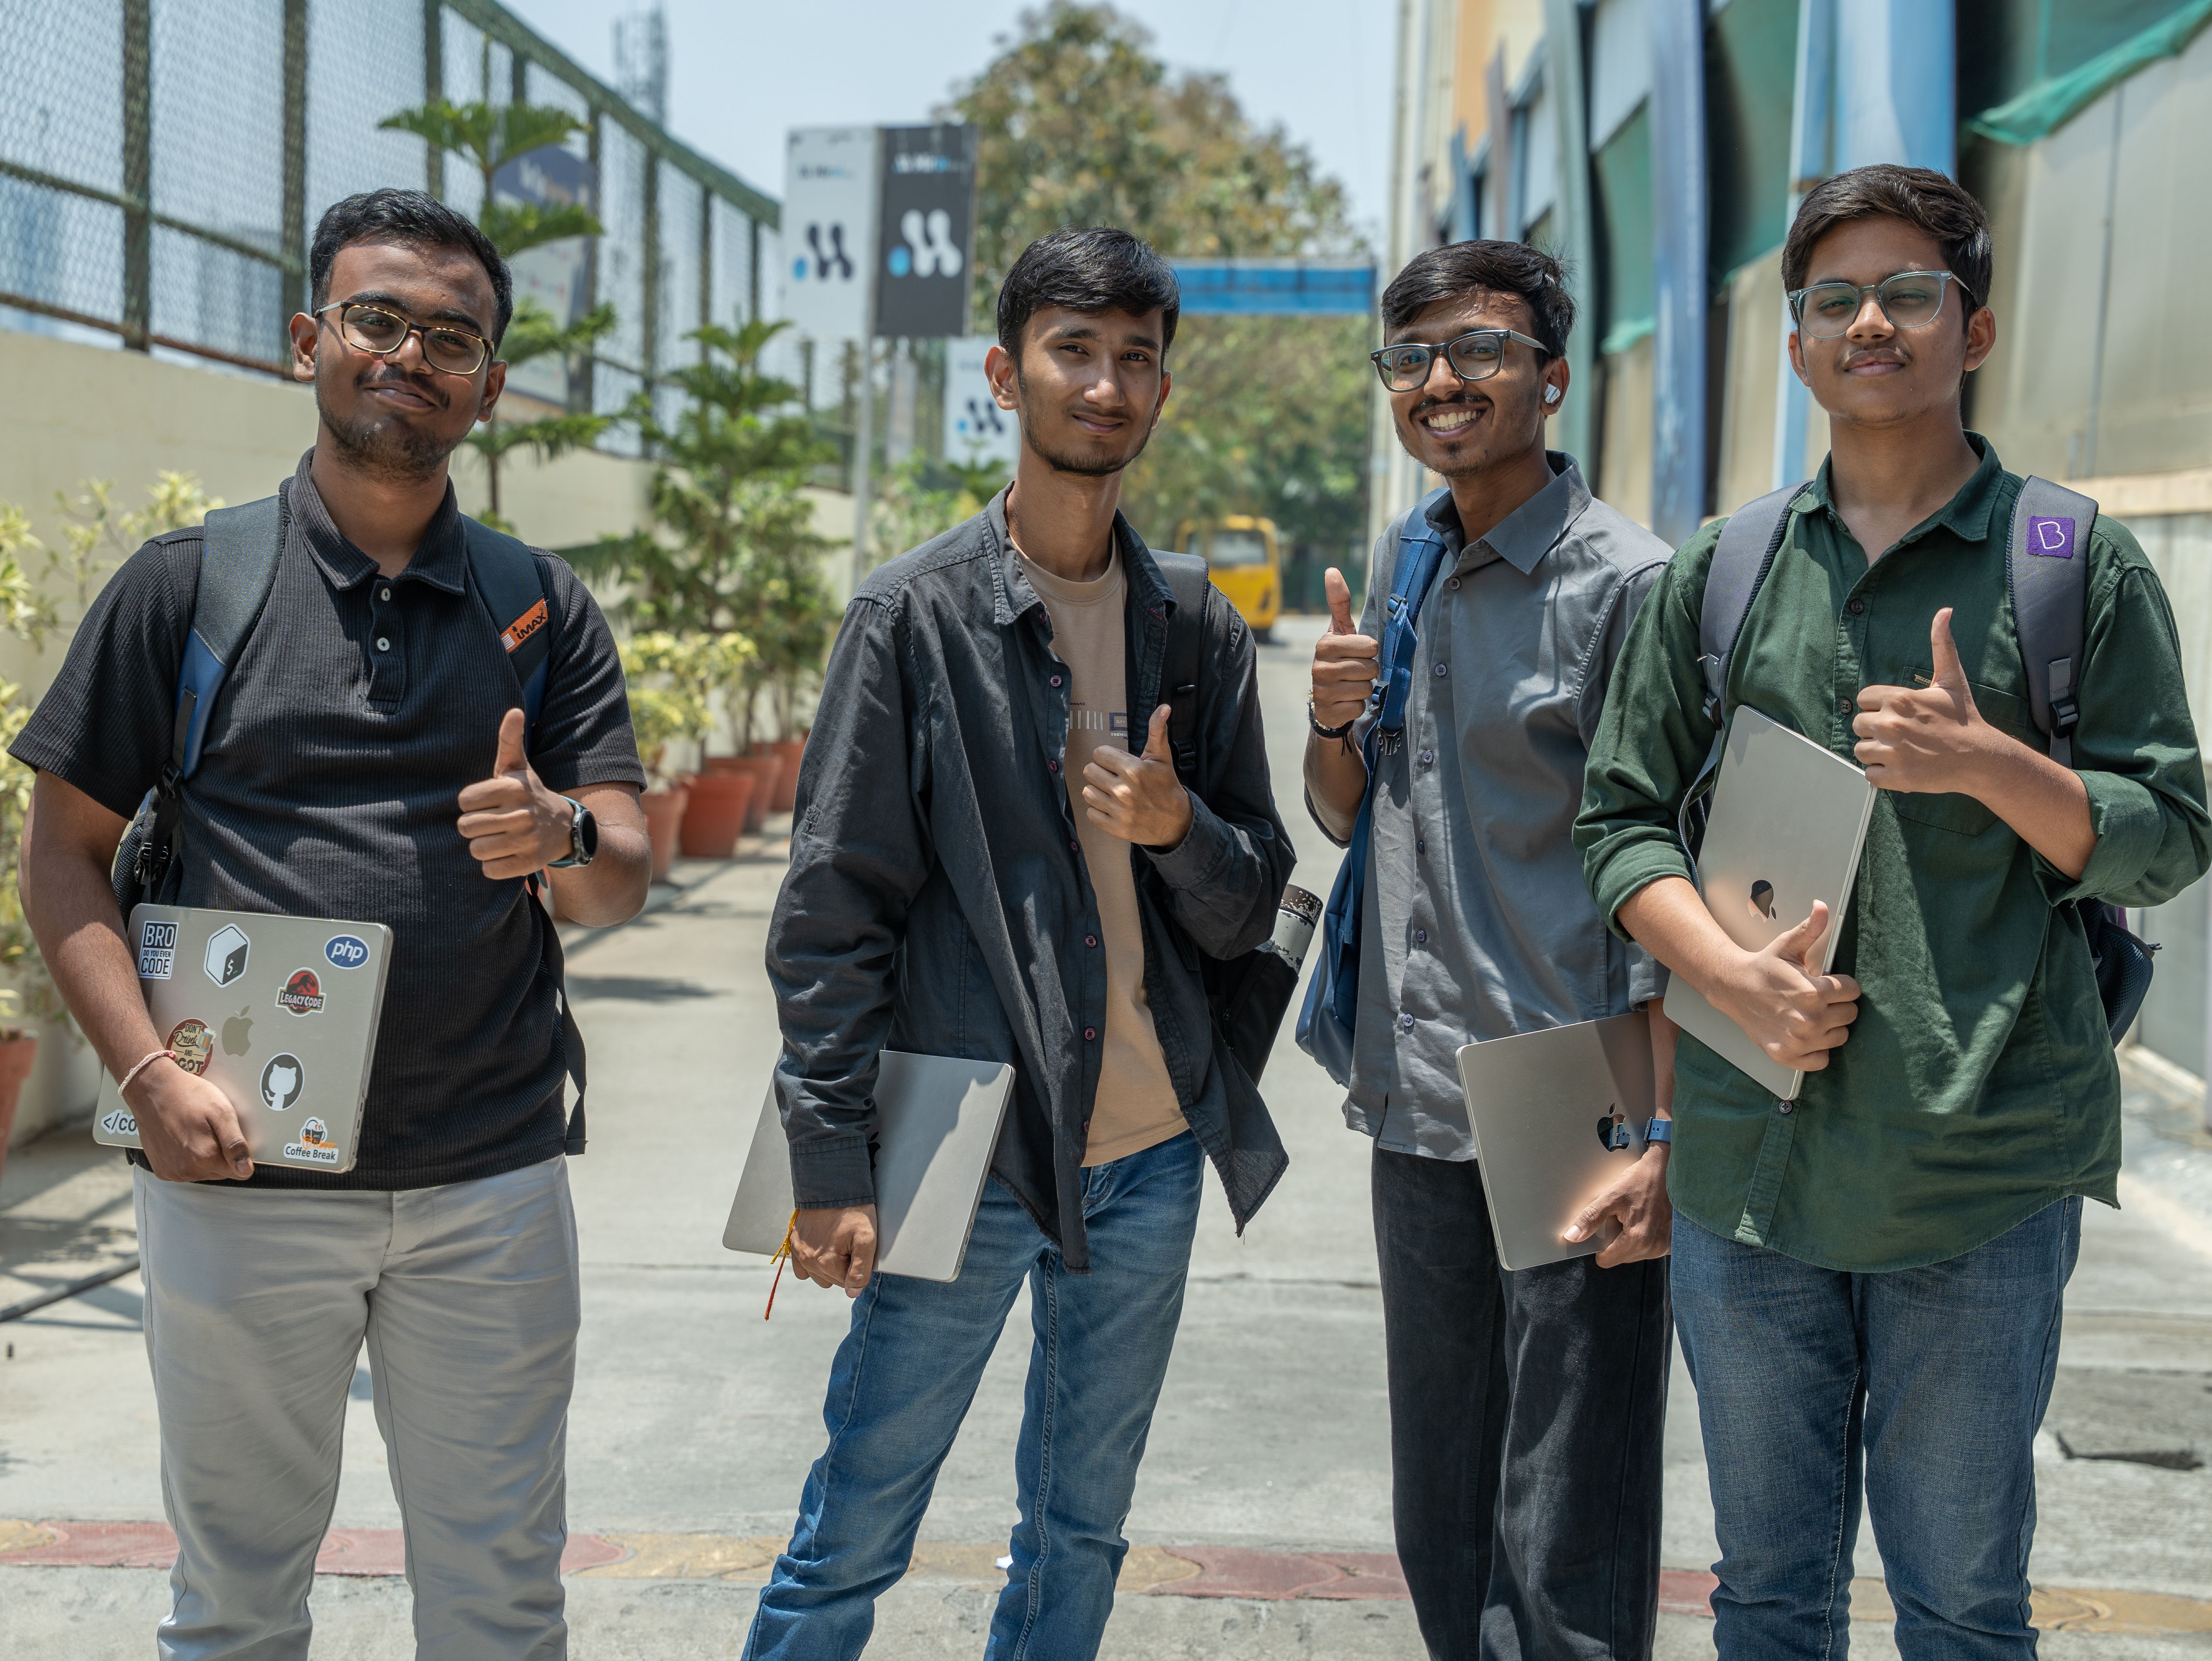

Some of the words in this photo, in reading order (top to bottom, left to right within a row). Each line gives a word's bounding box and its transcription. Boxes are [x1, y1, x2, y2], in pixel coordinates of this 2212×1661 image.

[144, 925, 174, 947] BRO
[330, 941, 363, 962] php
[141, 958, 170, 974] CODE
[185, 1024, 203, 1034] DON'T
[174, 1031, 200, 1049] Drink
[286, 1146, 311, 1157] Coffee
[313, 1149, 336, 1160] Break
